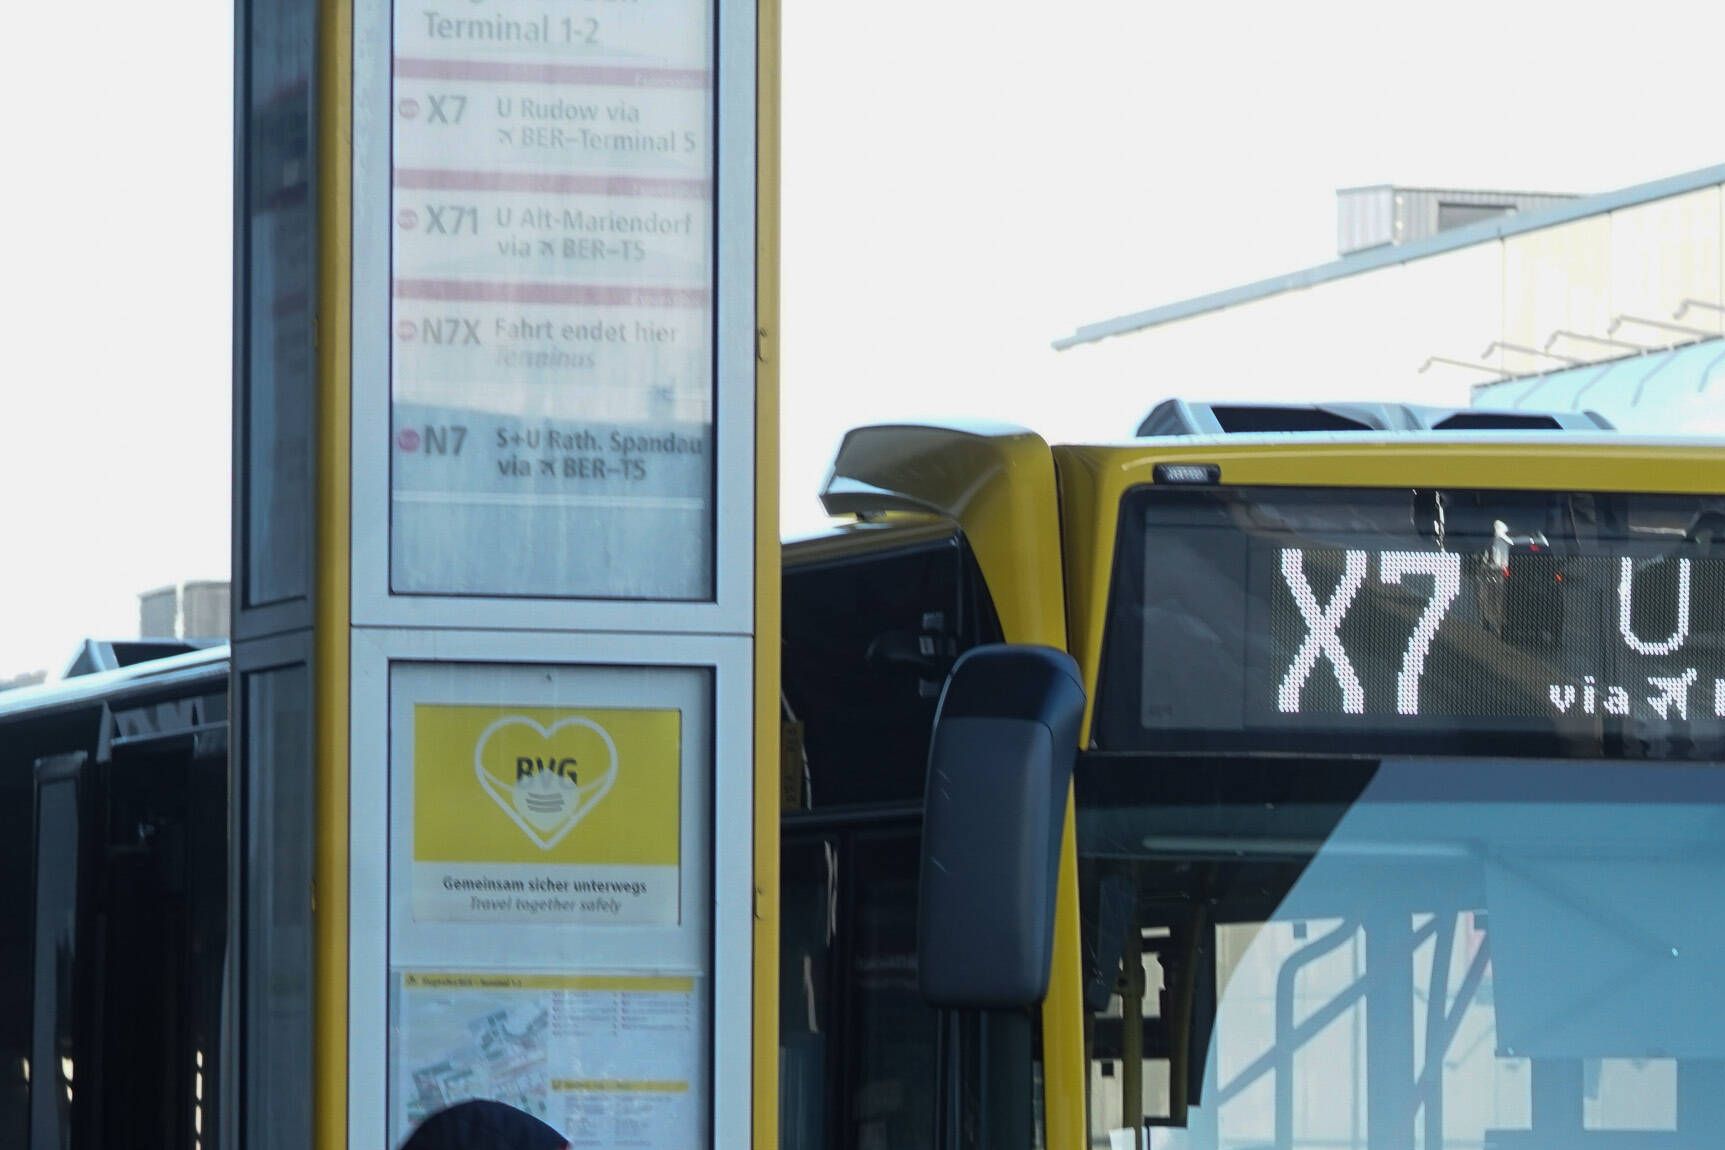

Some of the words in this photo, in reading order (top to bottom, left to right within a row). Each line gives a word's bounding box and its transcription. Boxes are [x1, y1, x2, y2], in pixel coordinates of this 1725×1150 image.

[424, 11, 550, 44] Terminal
[561, 18, 600, 44] 1-2
[427, 96, 469, 126] X7
[497, 97, 512, 118] U
[521, 99, 600, 122] Rudow
[607, 101, 640, 123] via
[683, 132, 697, 152] 5
[425, 205, 480, 236] X71
[497, 208, 512, 229] U
[521, 209, 692, 236] Alt-Mariendorf
[497, 238, 531, 257] via
[422, 318, 481, 346] N7X
[495, 318, 553, 342] Fahrt
[561, 319, 627, 343] endet
[635, 321, 679, 344] hier
[424, 425, 468, 456] N7
[497, 430, 540, 451] S+U
[548, 430, 603, 452] Rath.
[610, 431, 701, 457] Spandau
[497, 457, 531, 478] via
[1619, 556, 1690, 655] U
[1278, 548, 1460, 715] X7
[1549, 675, 1630, 716] via
[443, 876, 524, 892] Gemeinsam
[528, 878, 569, 893] sicher
[573, 880, 647, 894] unterwegs
[470, 896, 512, 911] Travel
[516, 897, 576, 914] together
[580, 899, 621, 915] safely
